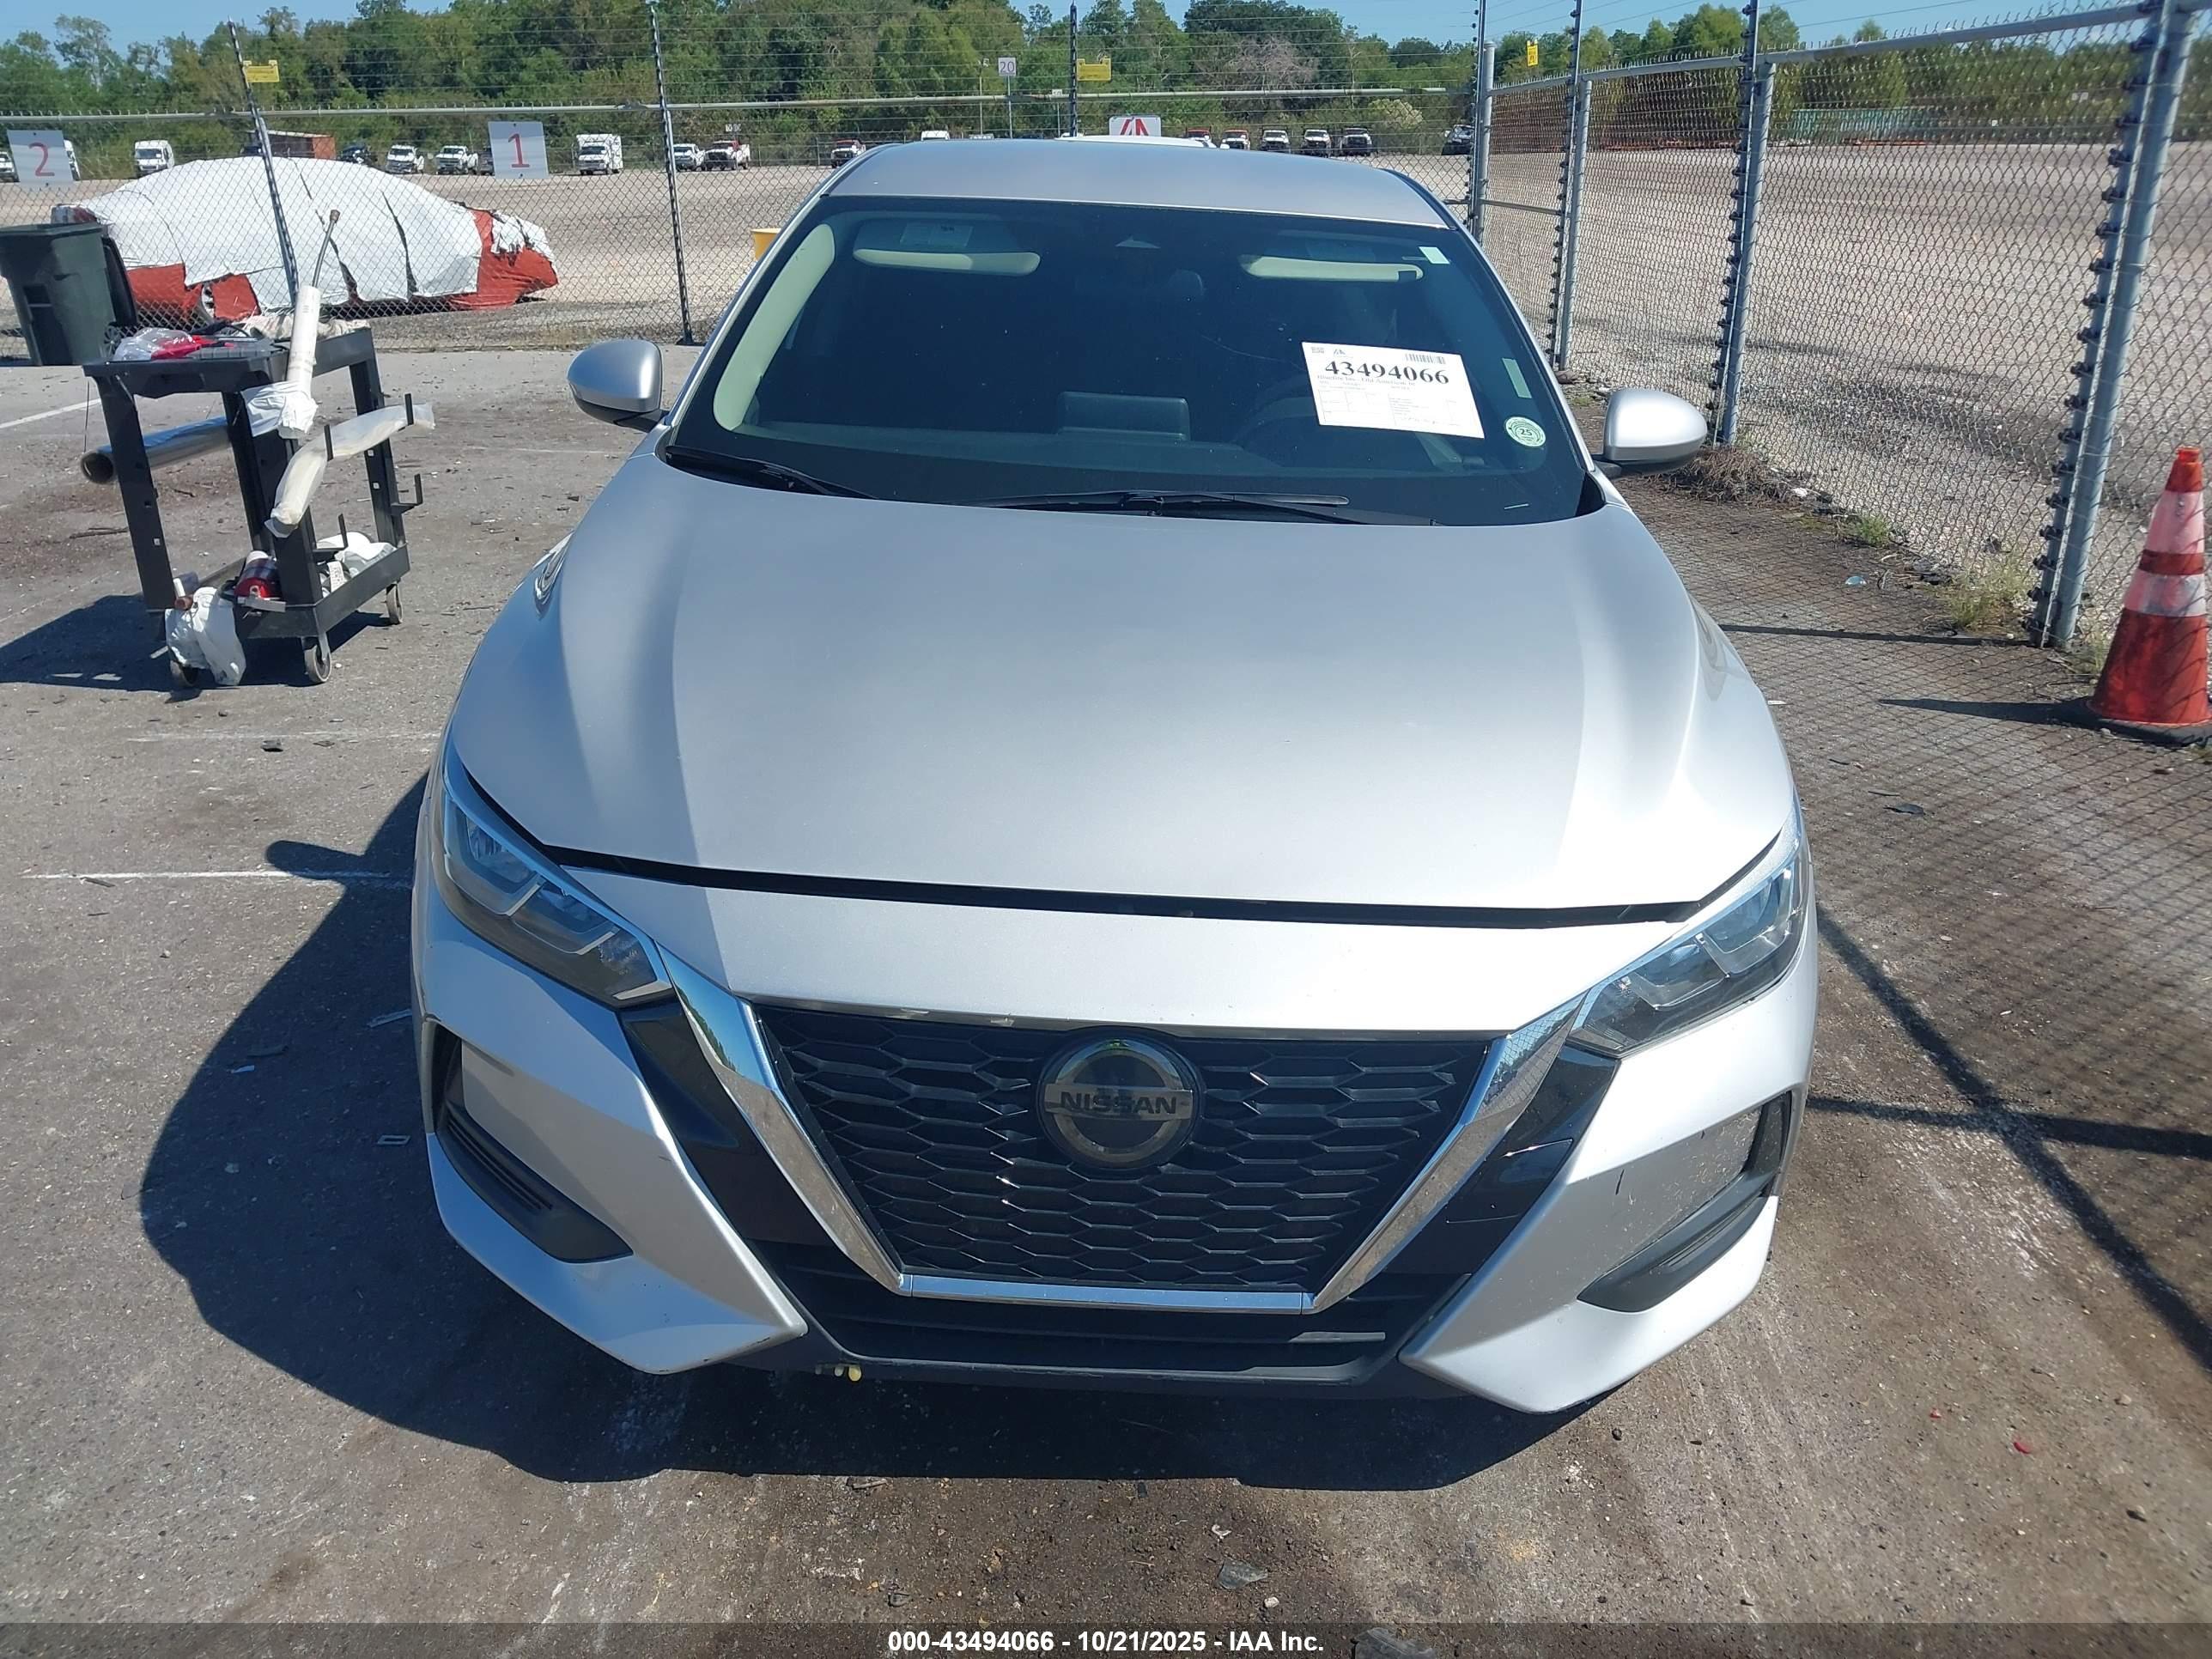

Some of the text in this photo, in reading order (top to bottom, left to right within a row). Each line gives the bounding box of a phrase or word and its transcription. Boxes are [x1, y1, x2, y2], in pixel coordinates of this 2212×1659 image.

[1000, 61, 1015, 73] 20
[28, 142, 55, 177] 2
[507, 133, 530, 168] 1
[1325, 360, 1449, 385] 43494066
[1519, 428, 1533, 436] 25
[1060, 1091, 1176, 1115] NISSAN
